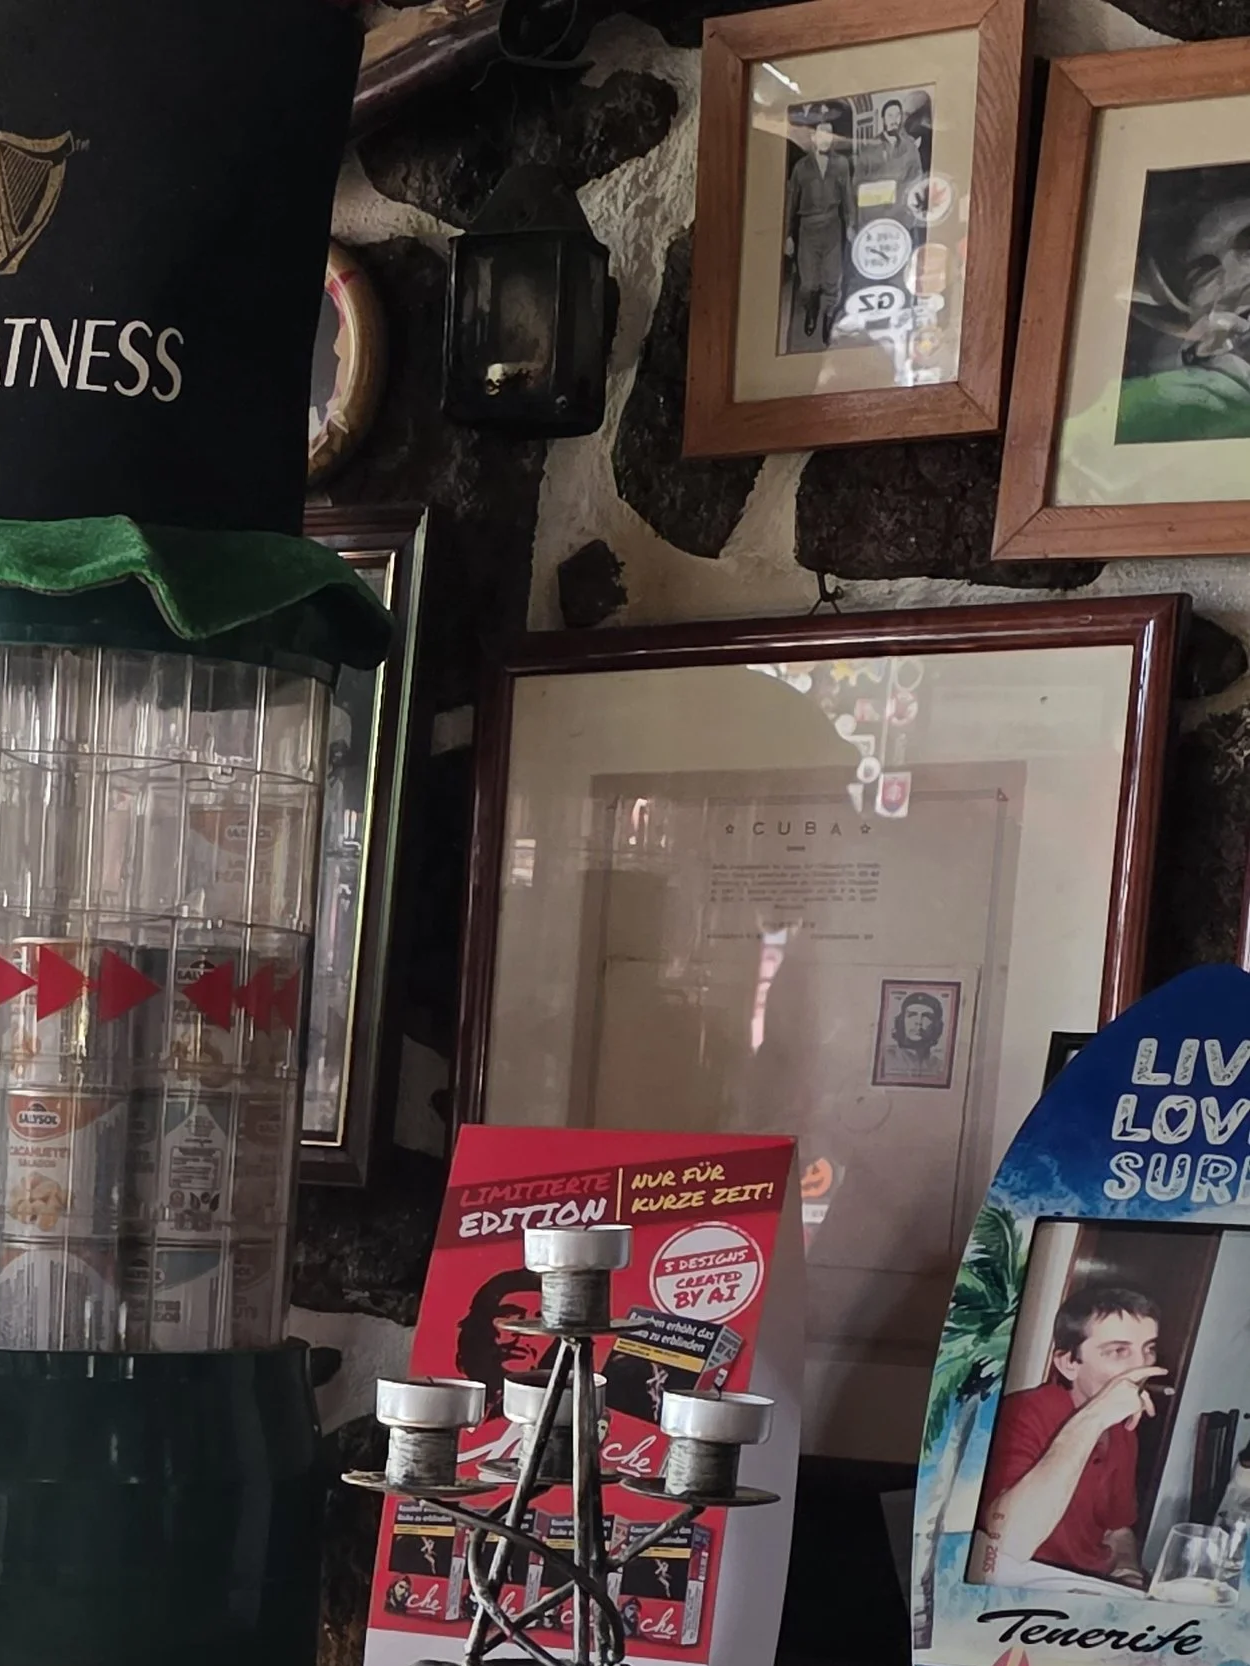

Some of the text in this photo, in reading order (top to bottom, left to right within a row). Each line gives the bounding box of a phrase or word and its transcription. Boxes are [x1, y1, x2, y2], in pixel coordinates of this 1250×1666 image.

[752, 821, 842, 836] CUBA
[18, 1113, 58, 1125] SALYSOL
[630, 1162, 726, 1191] NUR FÜR
[1103, 1152, 1250, 1205] SUR
[460, 1172, 611, 1208] LIMITIERTE
[631, 1182, 774, 1214] KURZE ZEIT!
[458, 1197, 607, 1239] EDITION
[664, 1249, 748, 1272] 5 DESIGNS
[676, 1270, 742, 1290] CREATED
[674, 1284, 739, 1310] BY AI
[661, 1333, 706, 1353] erblinden
[697, 1327, 715, 1341] das
[977, 1608, 1203, 1656] Tenerife
